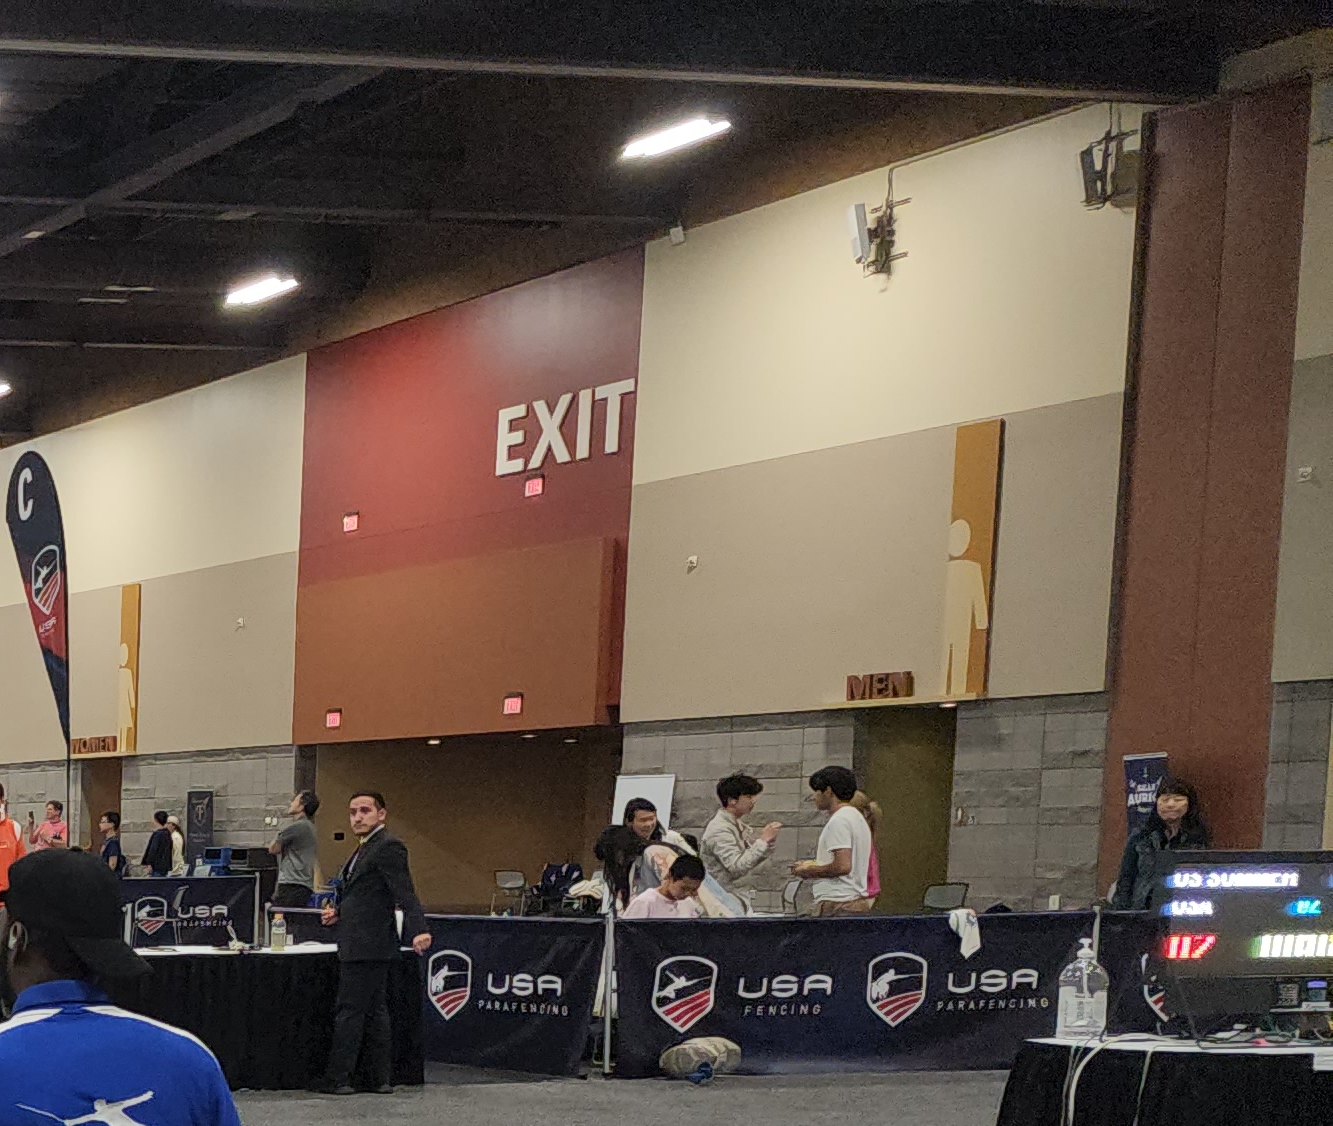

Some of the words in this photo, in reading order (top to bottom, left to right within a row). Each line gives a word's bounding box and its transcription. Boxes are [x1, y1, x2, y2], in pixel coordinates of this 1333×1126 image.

[495, 378, 636, 477] EXIT
[18, 467, 33, 521] C
[846, 671, 915, 701] MEN
[177, 904, 229, 919] USA
[487, 972, 563, 997] USA
[737, 974, 833, 999] USA
[947, 968, 1040, 994] USA
[477, 999, 570, 1017] PARAFENCING
[743, 1004, 822, 1017] FENCING
[936, 997, 1051, 1012] PARAFENCING
